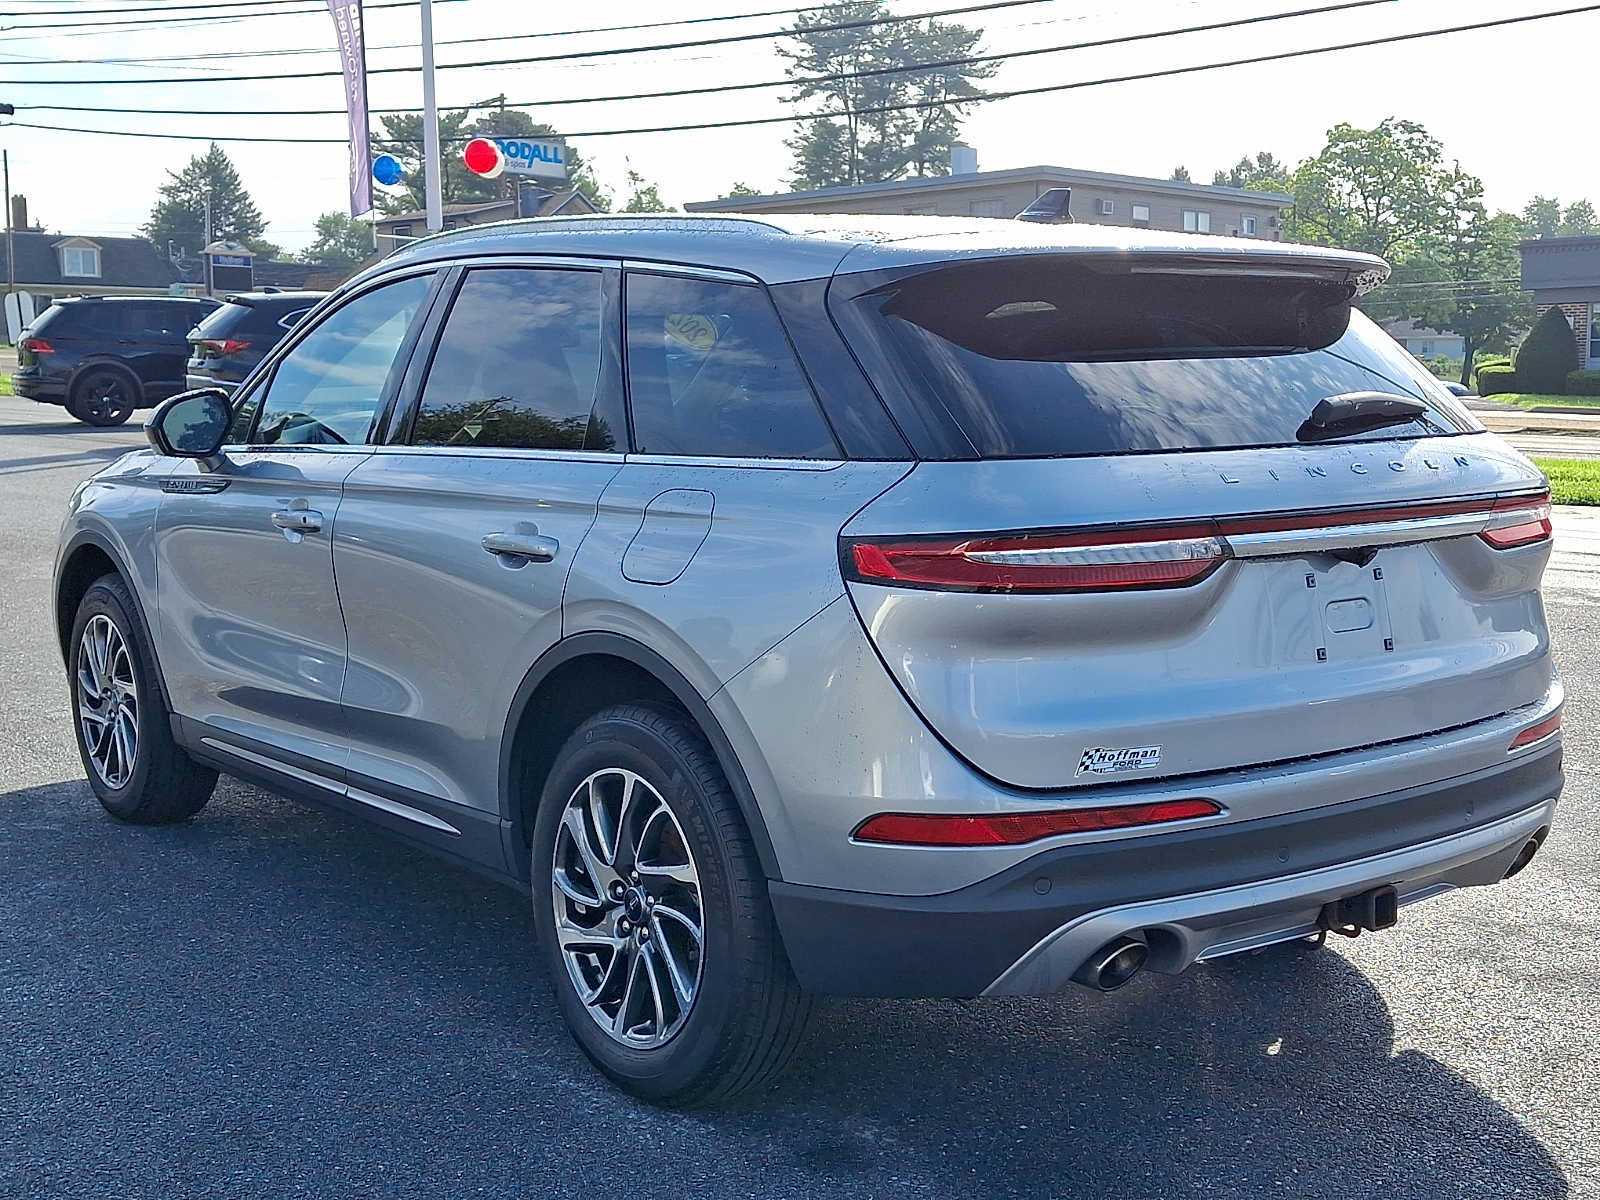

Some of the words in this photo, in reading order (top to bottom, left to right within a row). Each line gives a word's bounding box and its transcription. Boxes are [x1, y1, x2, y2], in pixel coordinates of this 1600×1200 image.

[496, 139, 563, 168] OODALL
[1219, 456, 1470, 484] LINCOLN
[1097, 749, 1157, 762] Hoffman
[1112, 759, 1142, 768] FORD
